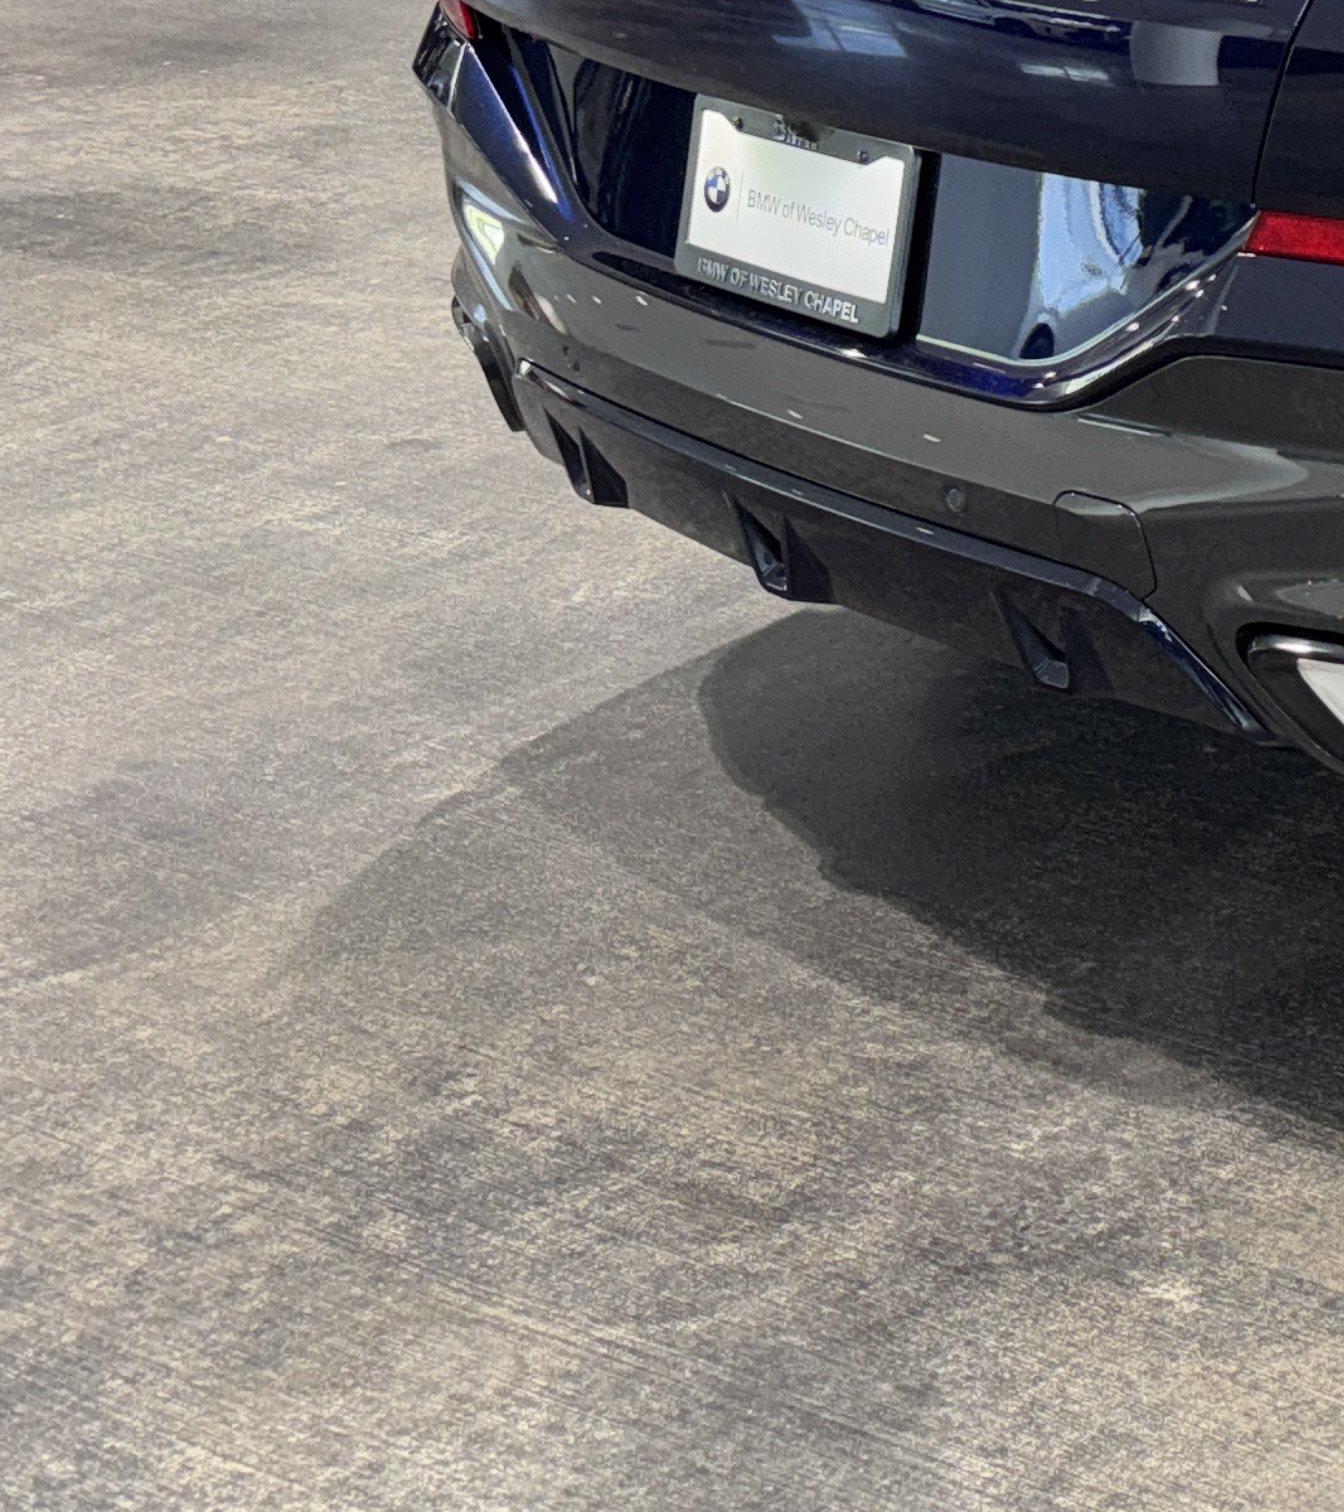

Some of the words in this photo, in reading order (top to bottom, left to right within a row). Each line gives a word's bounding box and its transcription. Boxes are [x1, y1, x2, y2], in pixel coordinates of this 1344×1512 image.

[747, 189, 780, 217] BMW
[782, 201, 796, 221] of
[796, 204, 842, 236] Wesley
[844, 217, 889, 247] Chapel
[697, 257, 729, 282] BMW
[729, 266, 748, 286] OF
[749, 272, 803, 306] WESLEY
[804, 290, 859, 323] CHAPEL
